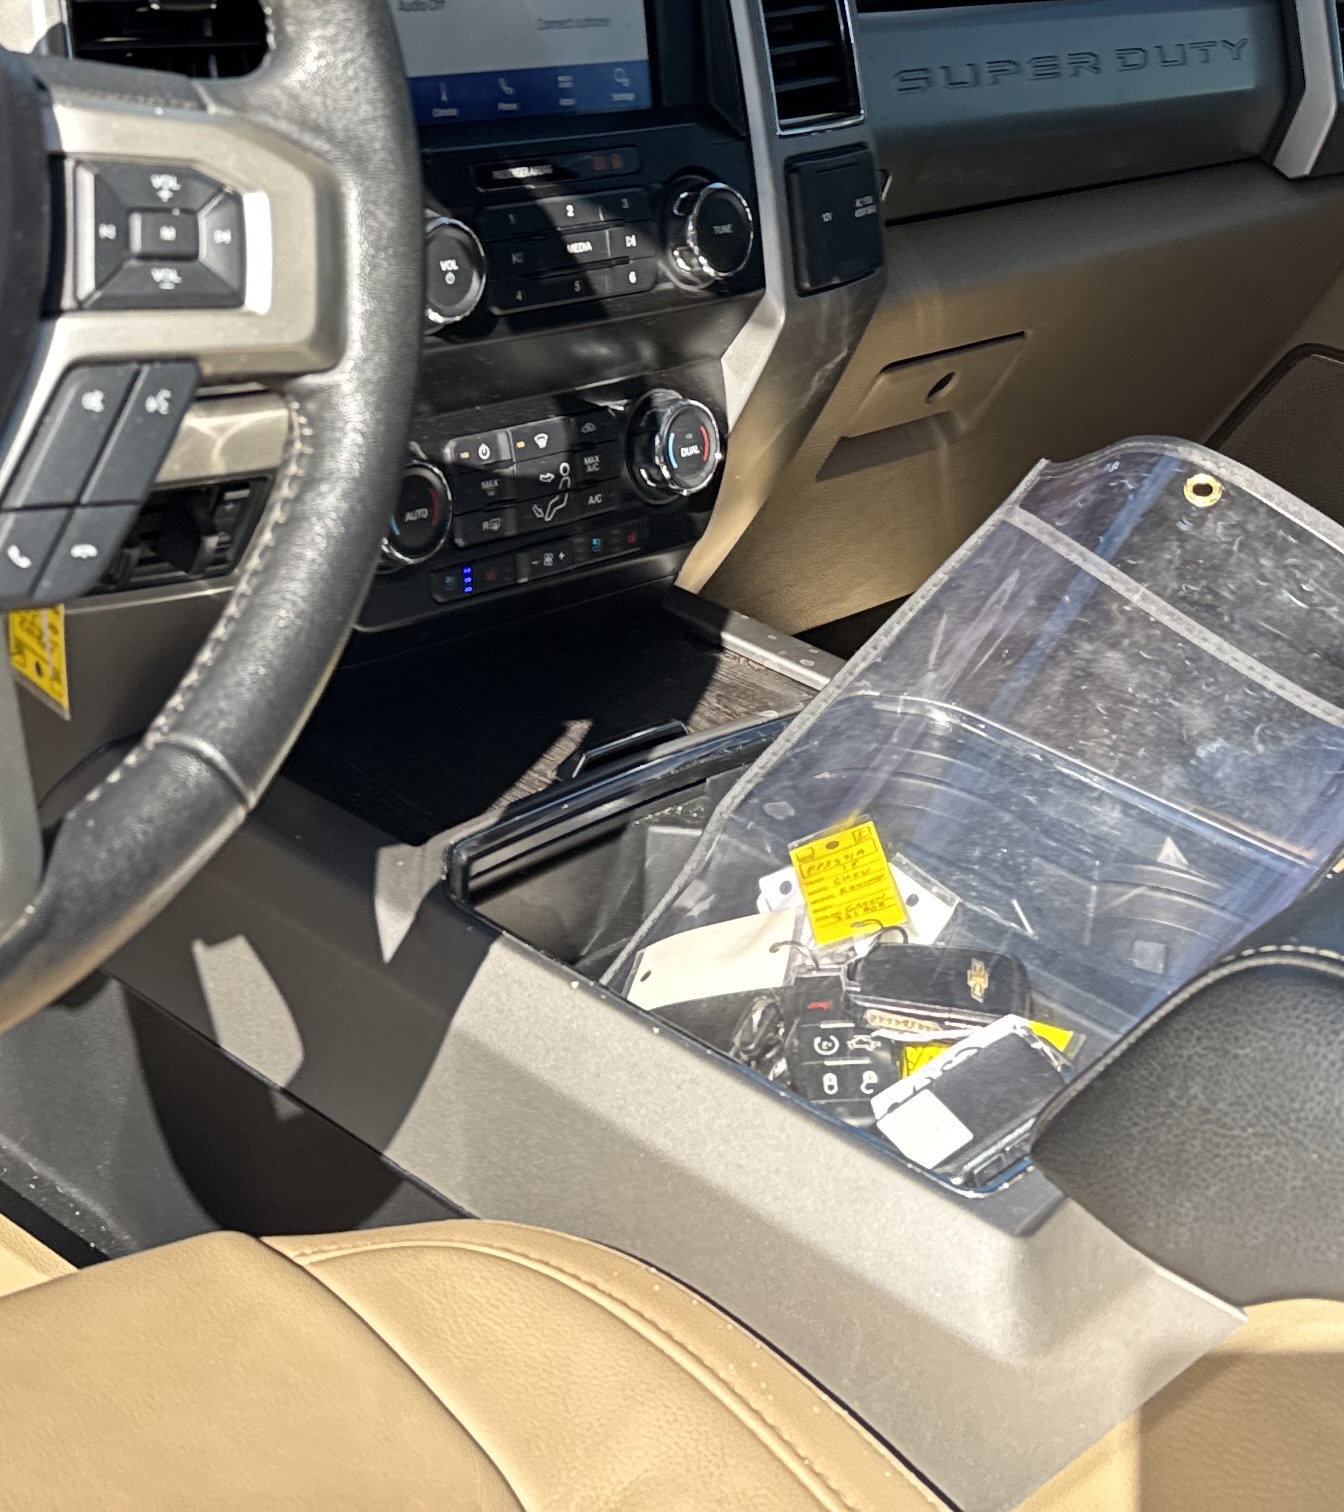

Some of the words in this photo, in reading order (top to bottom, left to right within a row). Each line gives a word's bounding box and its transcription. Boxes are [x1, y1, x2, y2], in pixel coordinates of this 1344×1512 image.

[893, 50, 1102, 95] SUPER
[1113, 37, 1250, 73] DUTY
[150, 173, 182, 191] VOL
[566, 203, 574, 217] 2
[621, 197, 629, 209] 3
[713, 223, 734, 235] TUNE
[566, 241, 593, 254] MEDIA
[439, 259, 459, 272] VOL
[150, 267, 183, 284] VOL
[515, 289, 524, 301] 4
[573, 280, 582, 292] 5
[628, 271, 637, 284] 6
[680, 444, 701, 458] DUAL
[583, 455, 601, 467] MAX
[481, 478, 499, 490] MAX
[587, 493, 603, 506] A/C
[405, 507, 429, 521] AUTO
